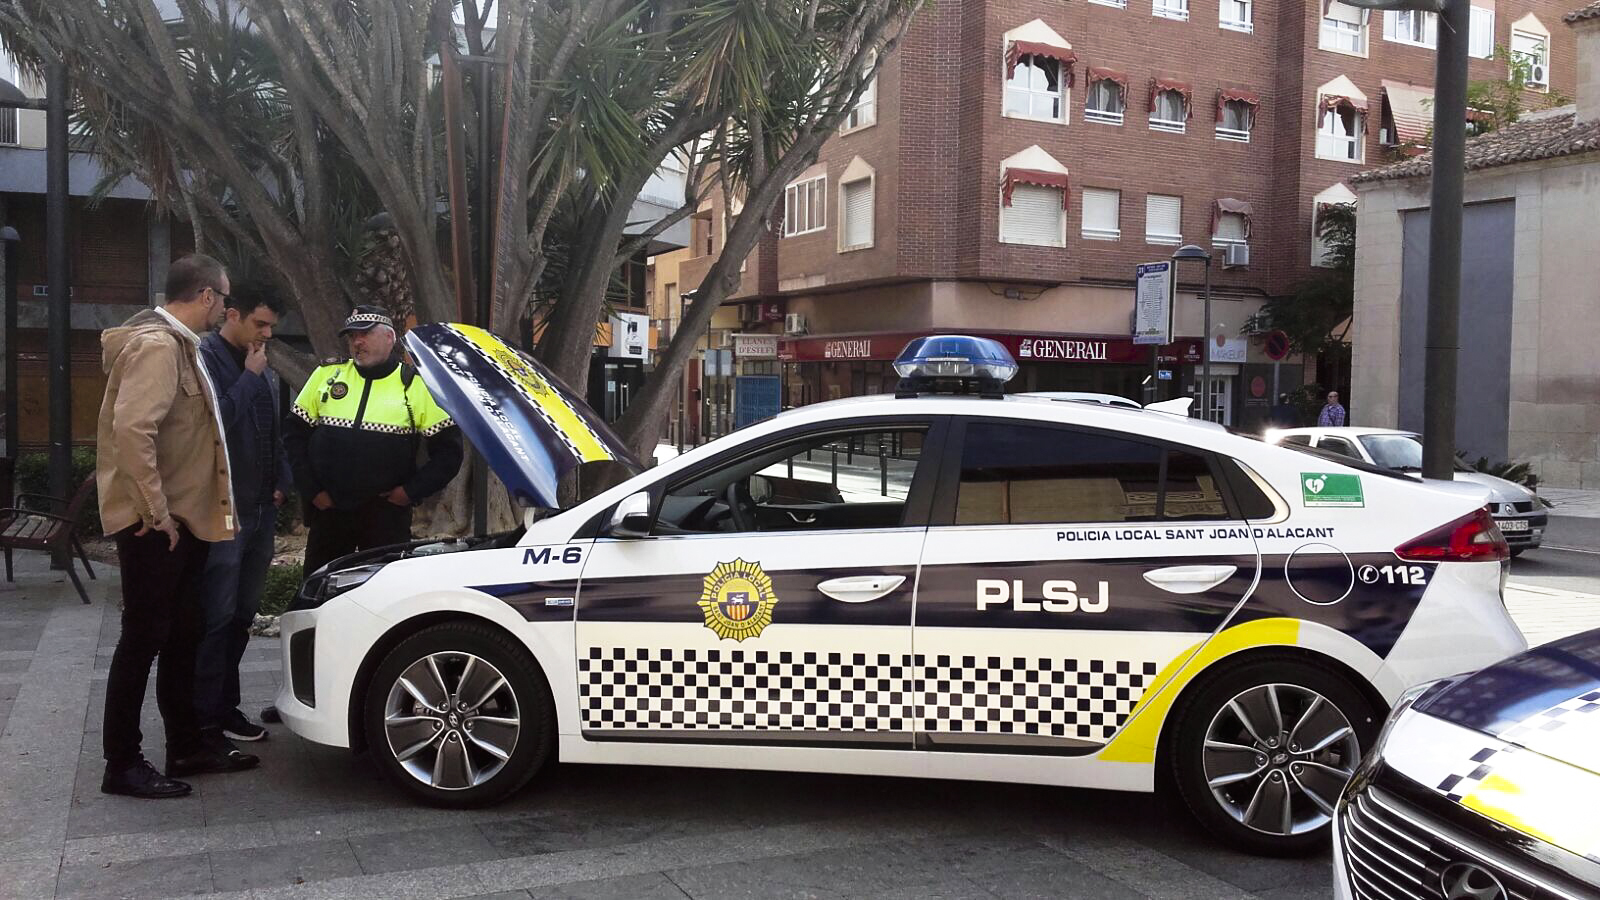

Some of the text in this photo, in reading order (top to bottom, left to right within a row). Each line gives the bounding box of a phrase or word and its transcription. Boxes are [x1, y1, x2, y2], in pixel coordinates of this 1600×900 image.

[831, 340, 871, 358] GENERALI
[1033, 339, 1107, 360] GENERALI
[438, 351, 466, 376] SANT
[1057, 526, 1336, 542] POLICIA LOCAL SANT JOAN D'ALACANT
[522, 547, 582, 565] M-6
[1381, 565, 1427, 585] 112
[711, 572, 766, 599] POLICIA LOCAL
[976, 578, 1110, 614] PLSJ
